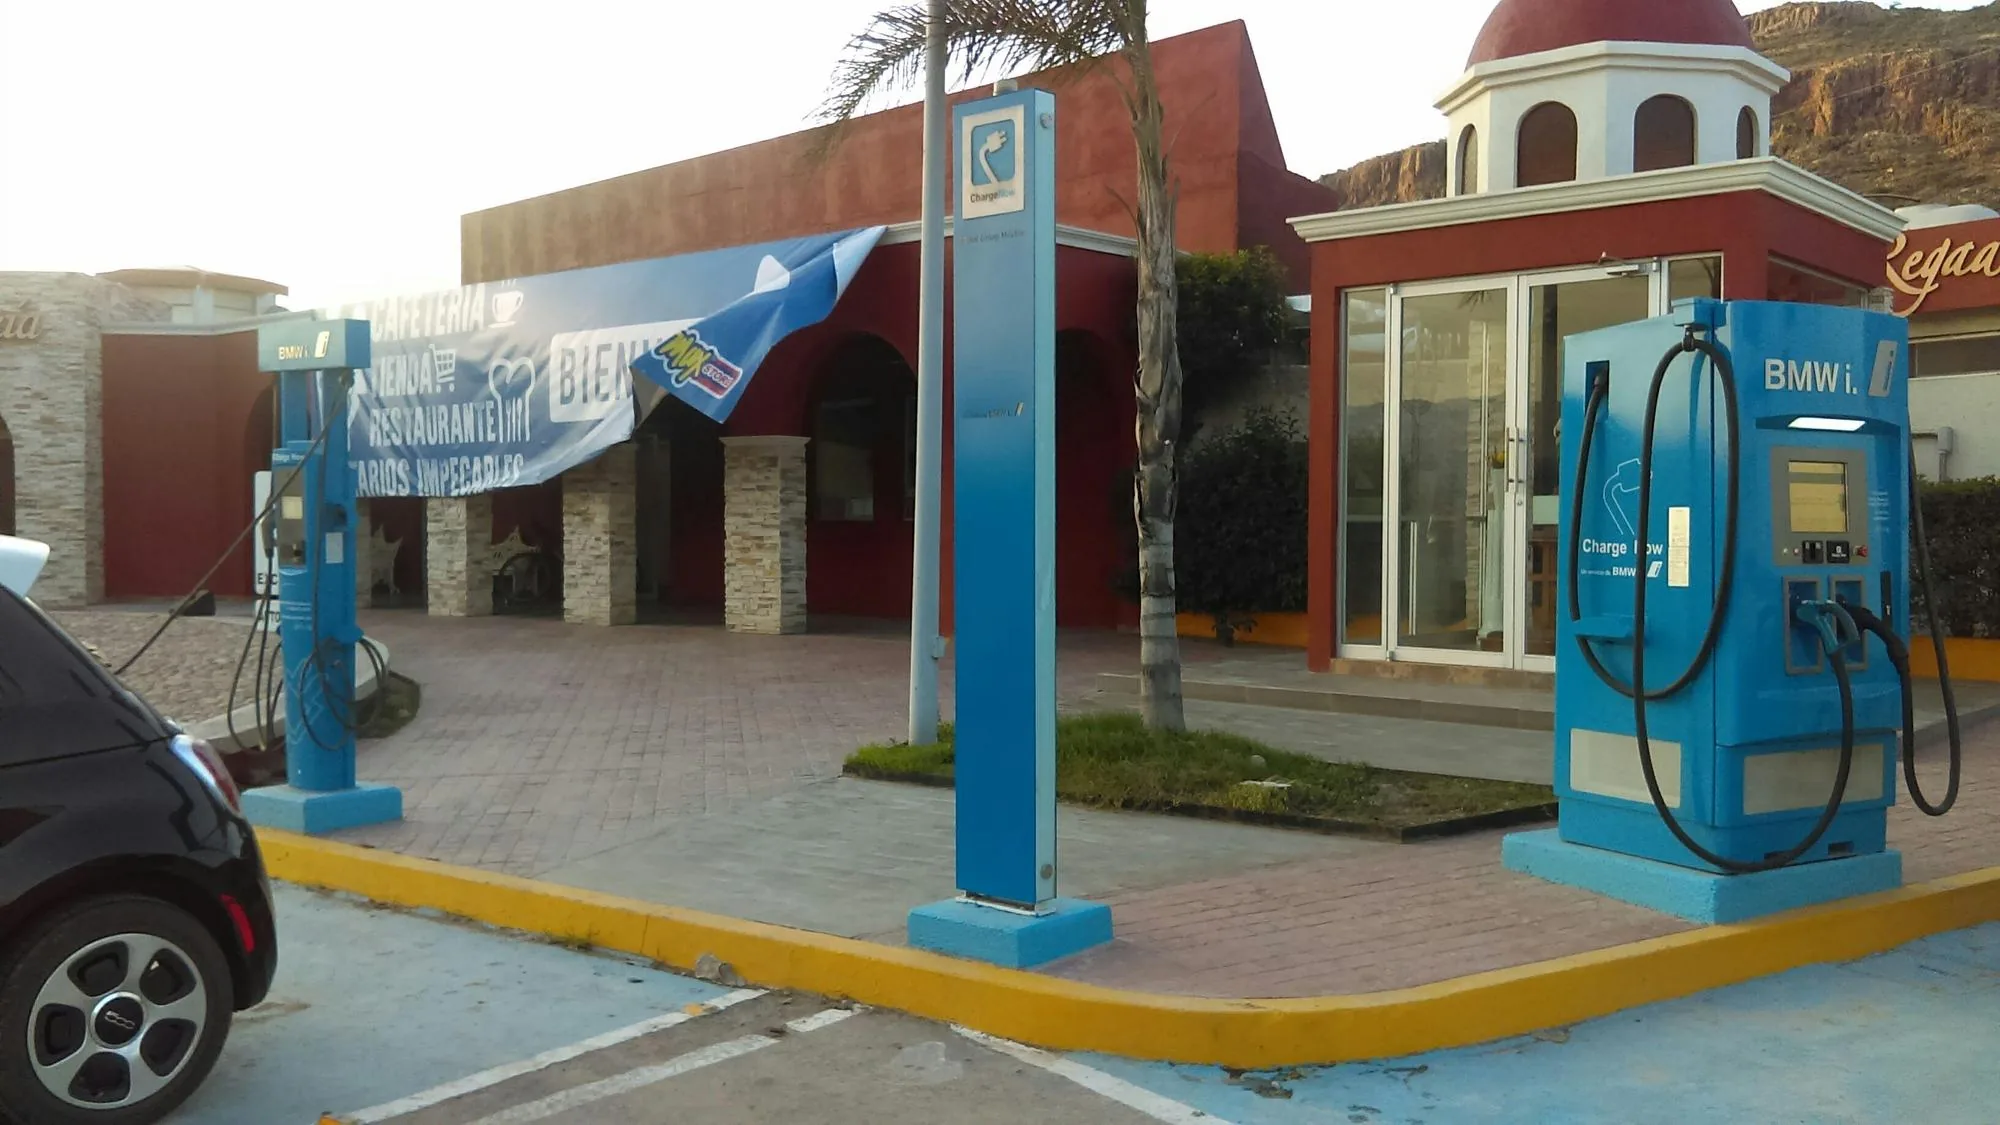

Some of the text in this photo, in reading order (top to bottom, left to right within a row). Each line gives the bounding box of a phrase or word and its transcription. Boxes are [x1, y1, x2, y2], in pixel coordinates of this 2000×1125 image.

[560, 338, 663, 406] BIEN
[1764, 358, 1839, 393] BMW
[369, 400, 496, 447] RESTAURANTE
[1582, 538, 1627, 557] Charge
[1612, 566, 1637, 577] BMW
